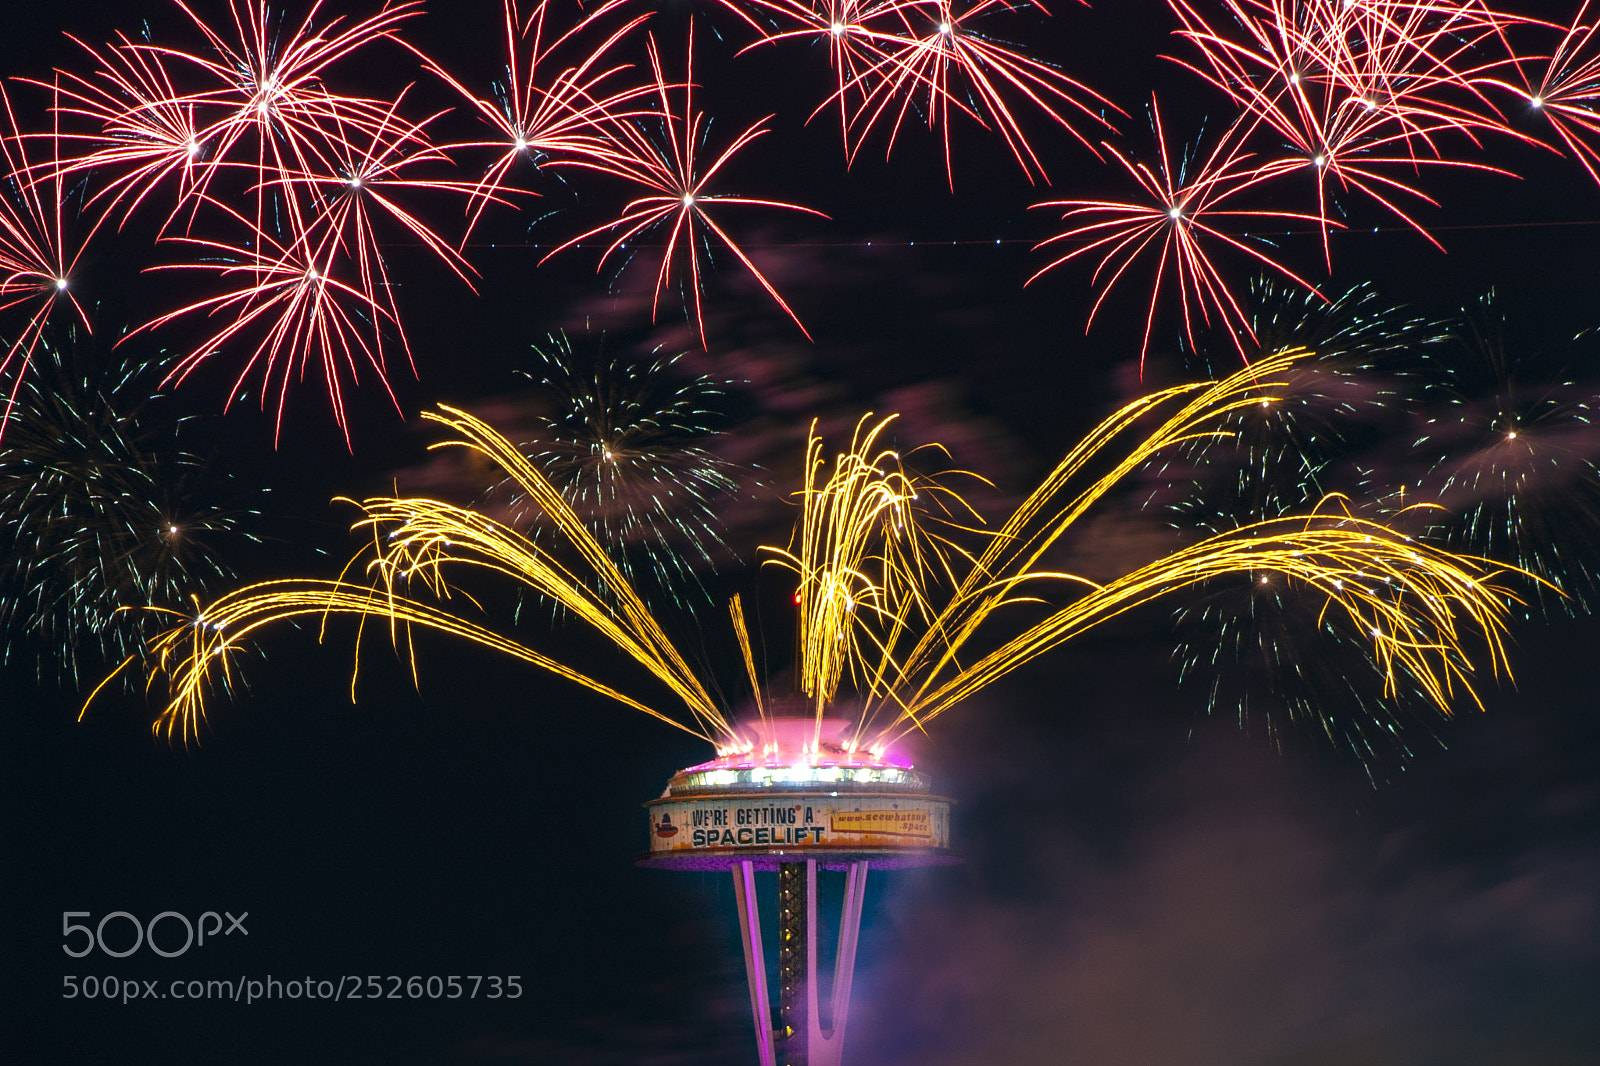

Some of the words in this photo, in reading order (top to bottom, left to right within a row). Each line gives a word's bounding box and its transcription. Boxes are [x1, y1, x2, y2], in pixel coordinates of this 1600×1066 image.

[692, 808, 728, 827] WE'RE
[736, 807, 796, 825] GETTING
[805, 806, 814, 823] A
[692, 826, 825, 847] SPACELIFT
